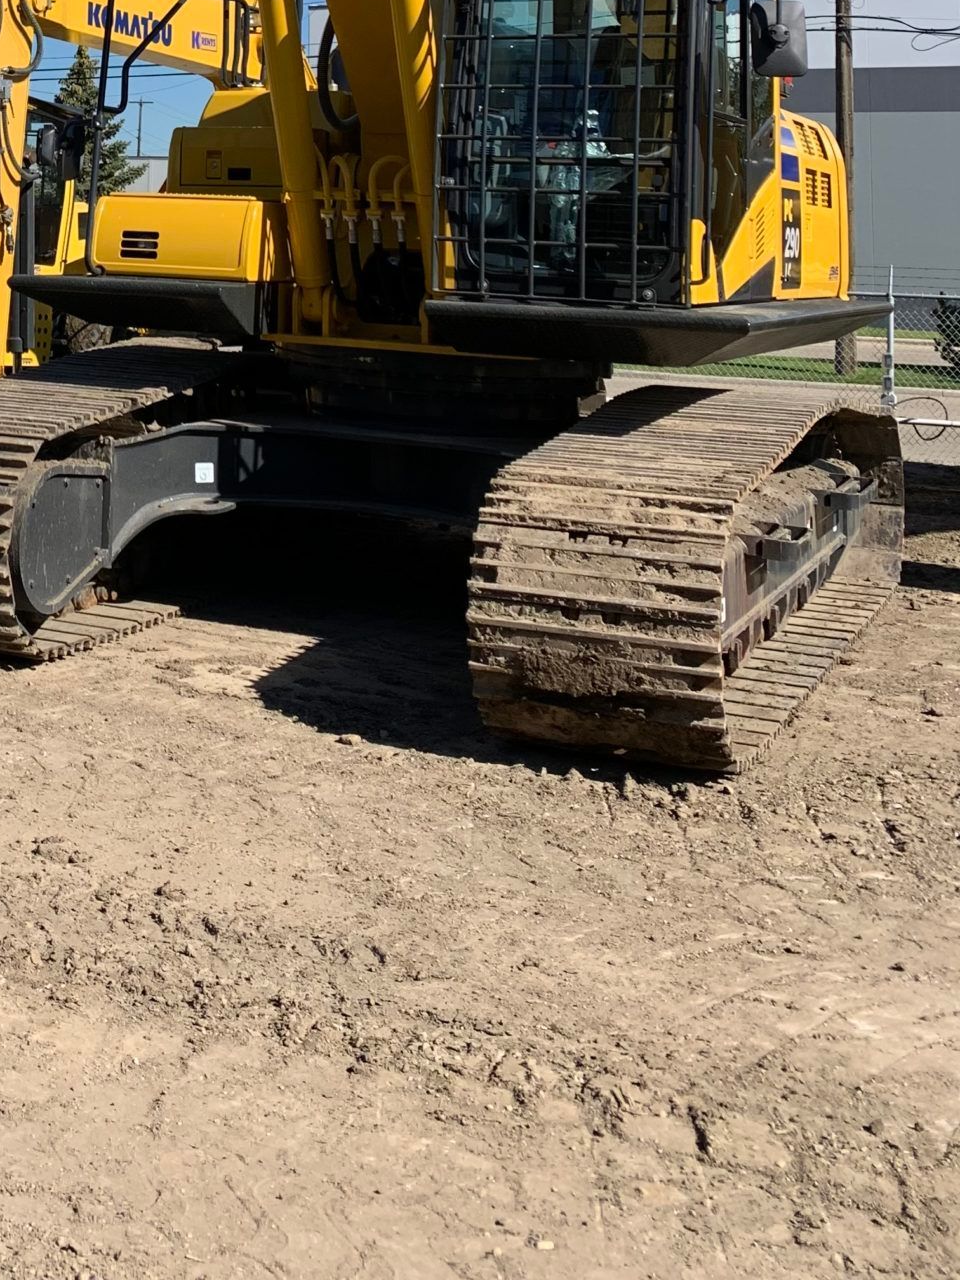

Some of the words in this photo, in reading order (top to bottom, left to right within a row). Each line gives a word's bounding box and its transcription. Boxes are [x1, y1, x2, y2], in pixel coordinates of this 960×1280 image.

[191, 30, 200, 50] K
[783, 198, 793, 222] PC
[784, 227, 800, 259] 290
